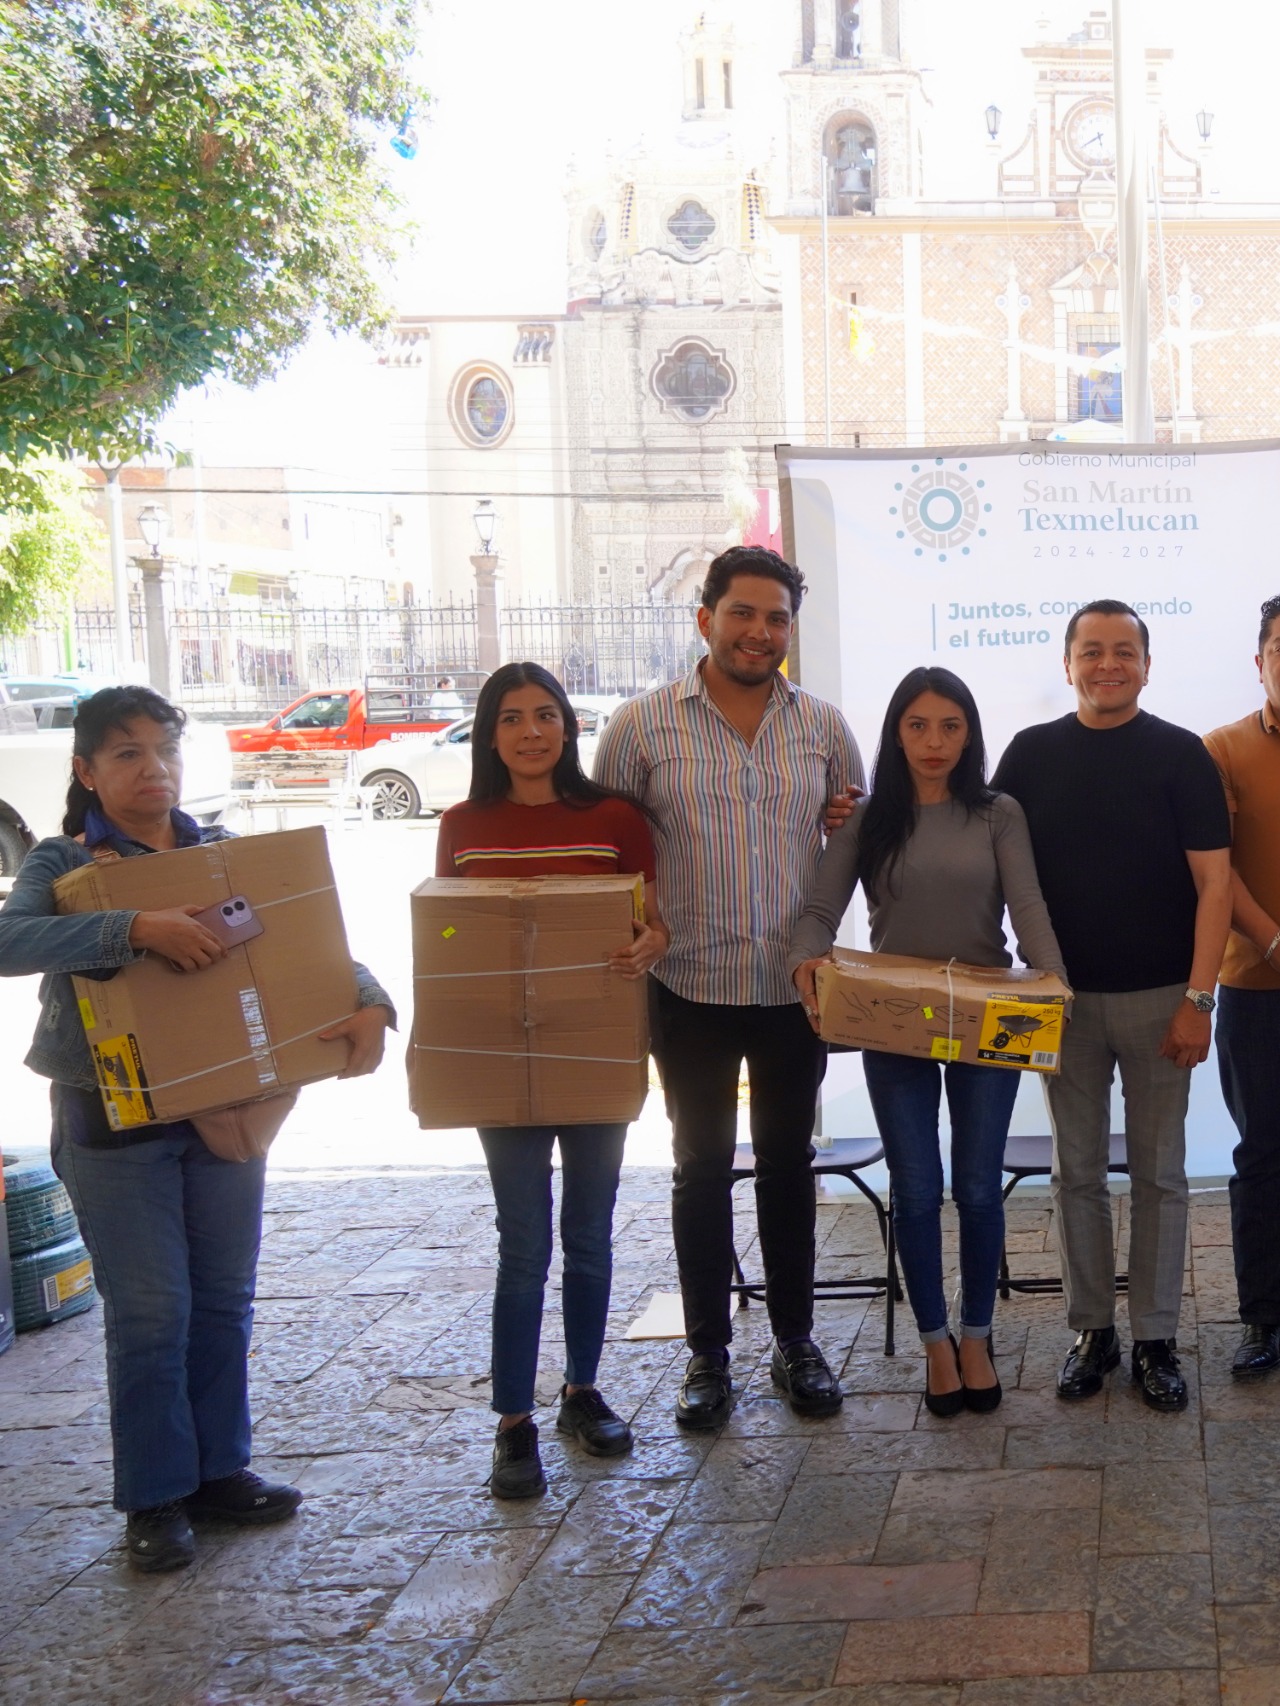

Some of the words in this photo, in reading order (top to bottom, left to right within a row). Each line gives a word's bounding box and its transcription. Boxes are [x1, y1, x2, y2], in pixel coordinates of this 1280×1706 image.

[1018, 452, 1101, 468] Gobierno
[1108, 452, 1196, 471] Municipal
[1022, 480, 1078, 503] San
[1087, 478, 1193, 503] Martín
[1017, 507, 1200, 532] Texmelucan
[948, 602, 1032, 621] Juntos,
[949, 631, 968, 647] el
[978, 629, 1050, 647] futuro
[991, 993, 1020, 1001] PRETUL
